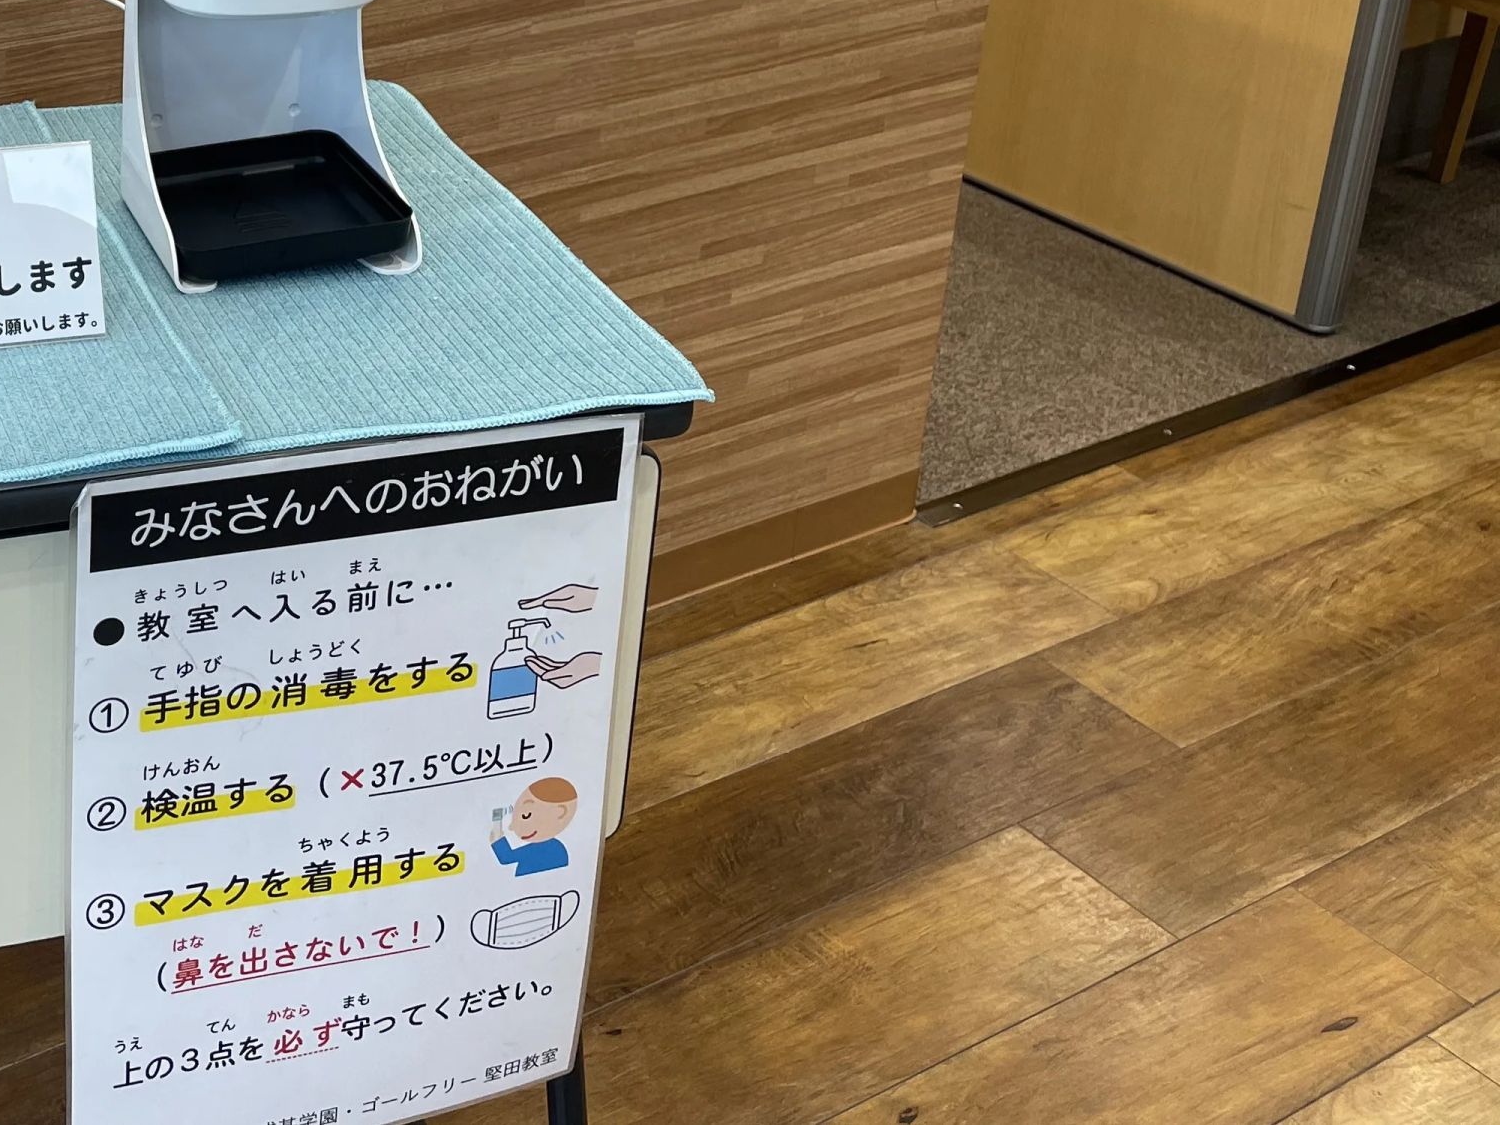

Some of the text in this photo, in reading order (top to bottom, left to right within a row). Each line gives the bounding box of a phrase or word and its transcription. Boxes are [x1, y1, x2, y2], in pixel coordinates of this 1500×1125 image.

[130, 453, 585, 549] みなさんへのおねがい
[134, 557, 383, 605] きょうしつ はい まえ
[149, 637, 362, 683] てゆび しょうどく
[144, 651, 475, 727] 手指の消毒をする
[143, 755, 221, 782] けんおん
[140, 773, 295, 825] 検温する
[298, 826, 392, 853] ちゃくよう
[142, 841, 462, 918] マスクを着用する
[173, 923, 264, 953] はな だ
[113, 992, 371, 1054] うえ てん かなら まも
[267, 1046, 560, 1125] 学園・ゴールフリー 堅田教室
